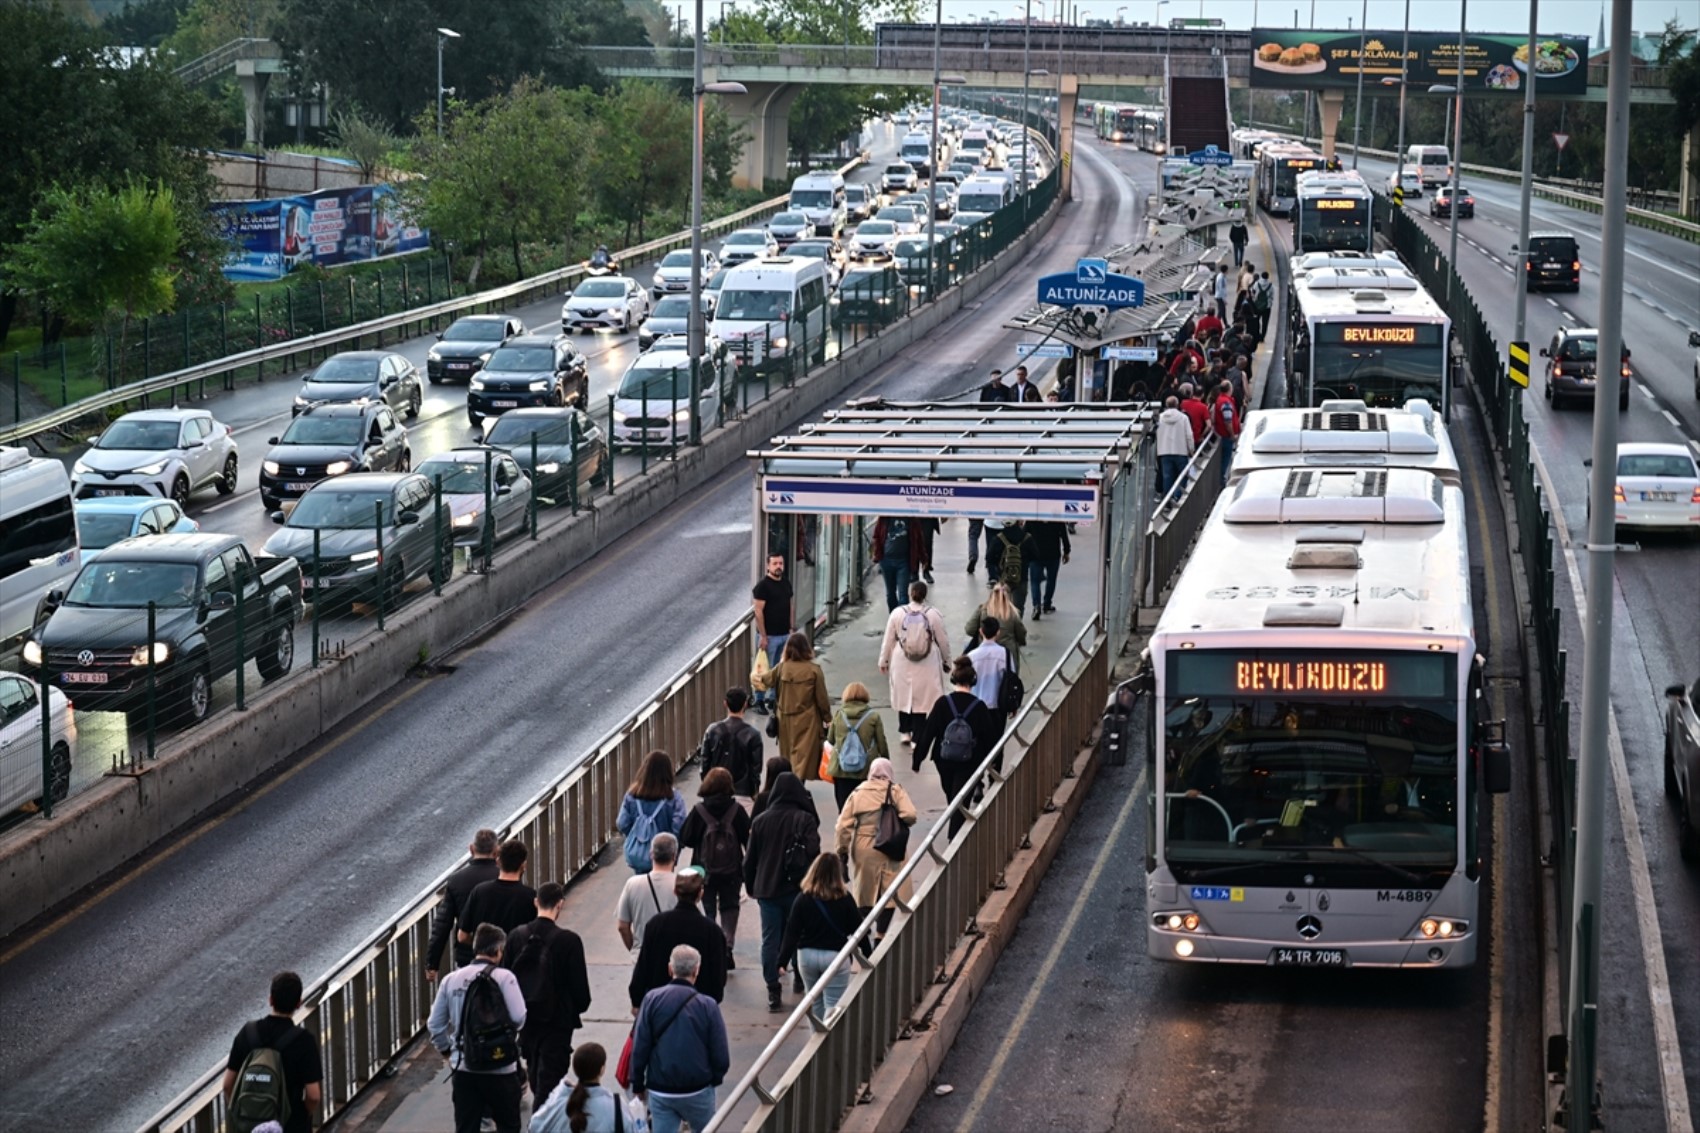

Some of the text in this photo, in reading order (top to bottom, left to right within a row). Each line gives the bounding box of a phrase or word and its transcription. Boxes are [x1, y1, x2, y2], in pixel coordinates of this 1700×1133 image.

[1331, 49, 1349, 60] ŞEF
[1046, 286, 1136, 302] ALTUNİZADE
[899, 485, 955, 496] ALTUNİZADE
[1377, 890, 1433, 903] M-4889
[1278, 950, 1342, 964] 34 TR 7016
